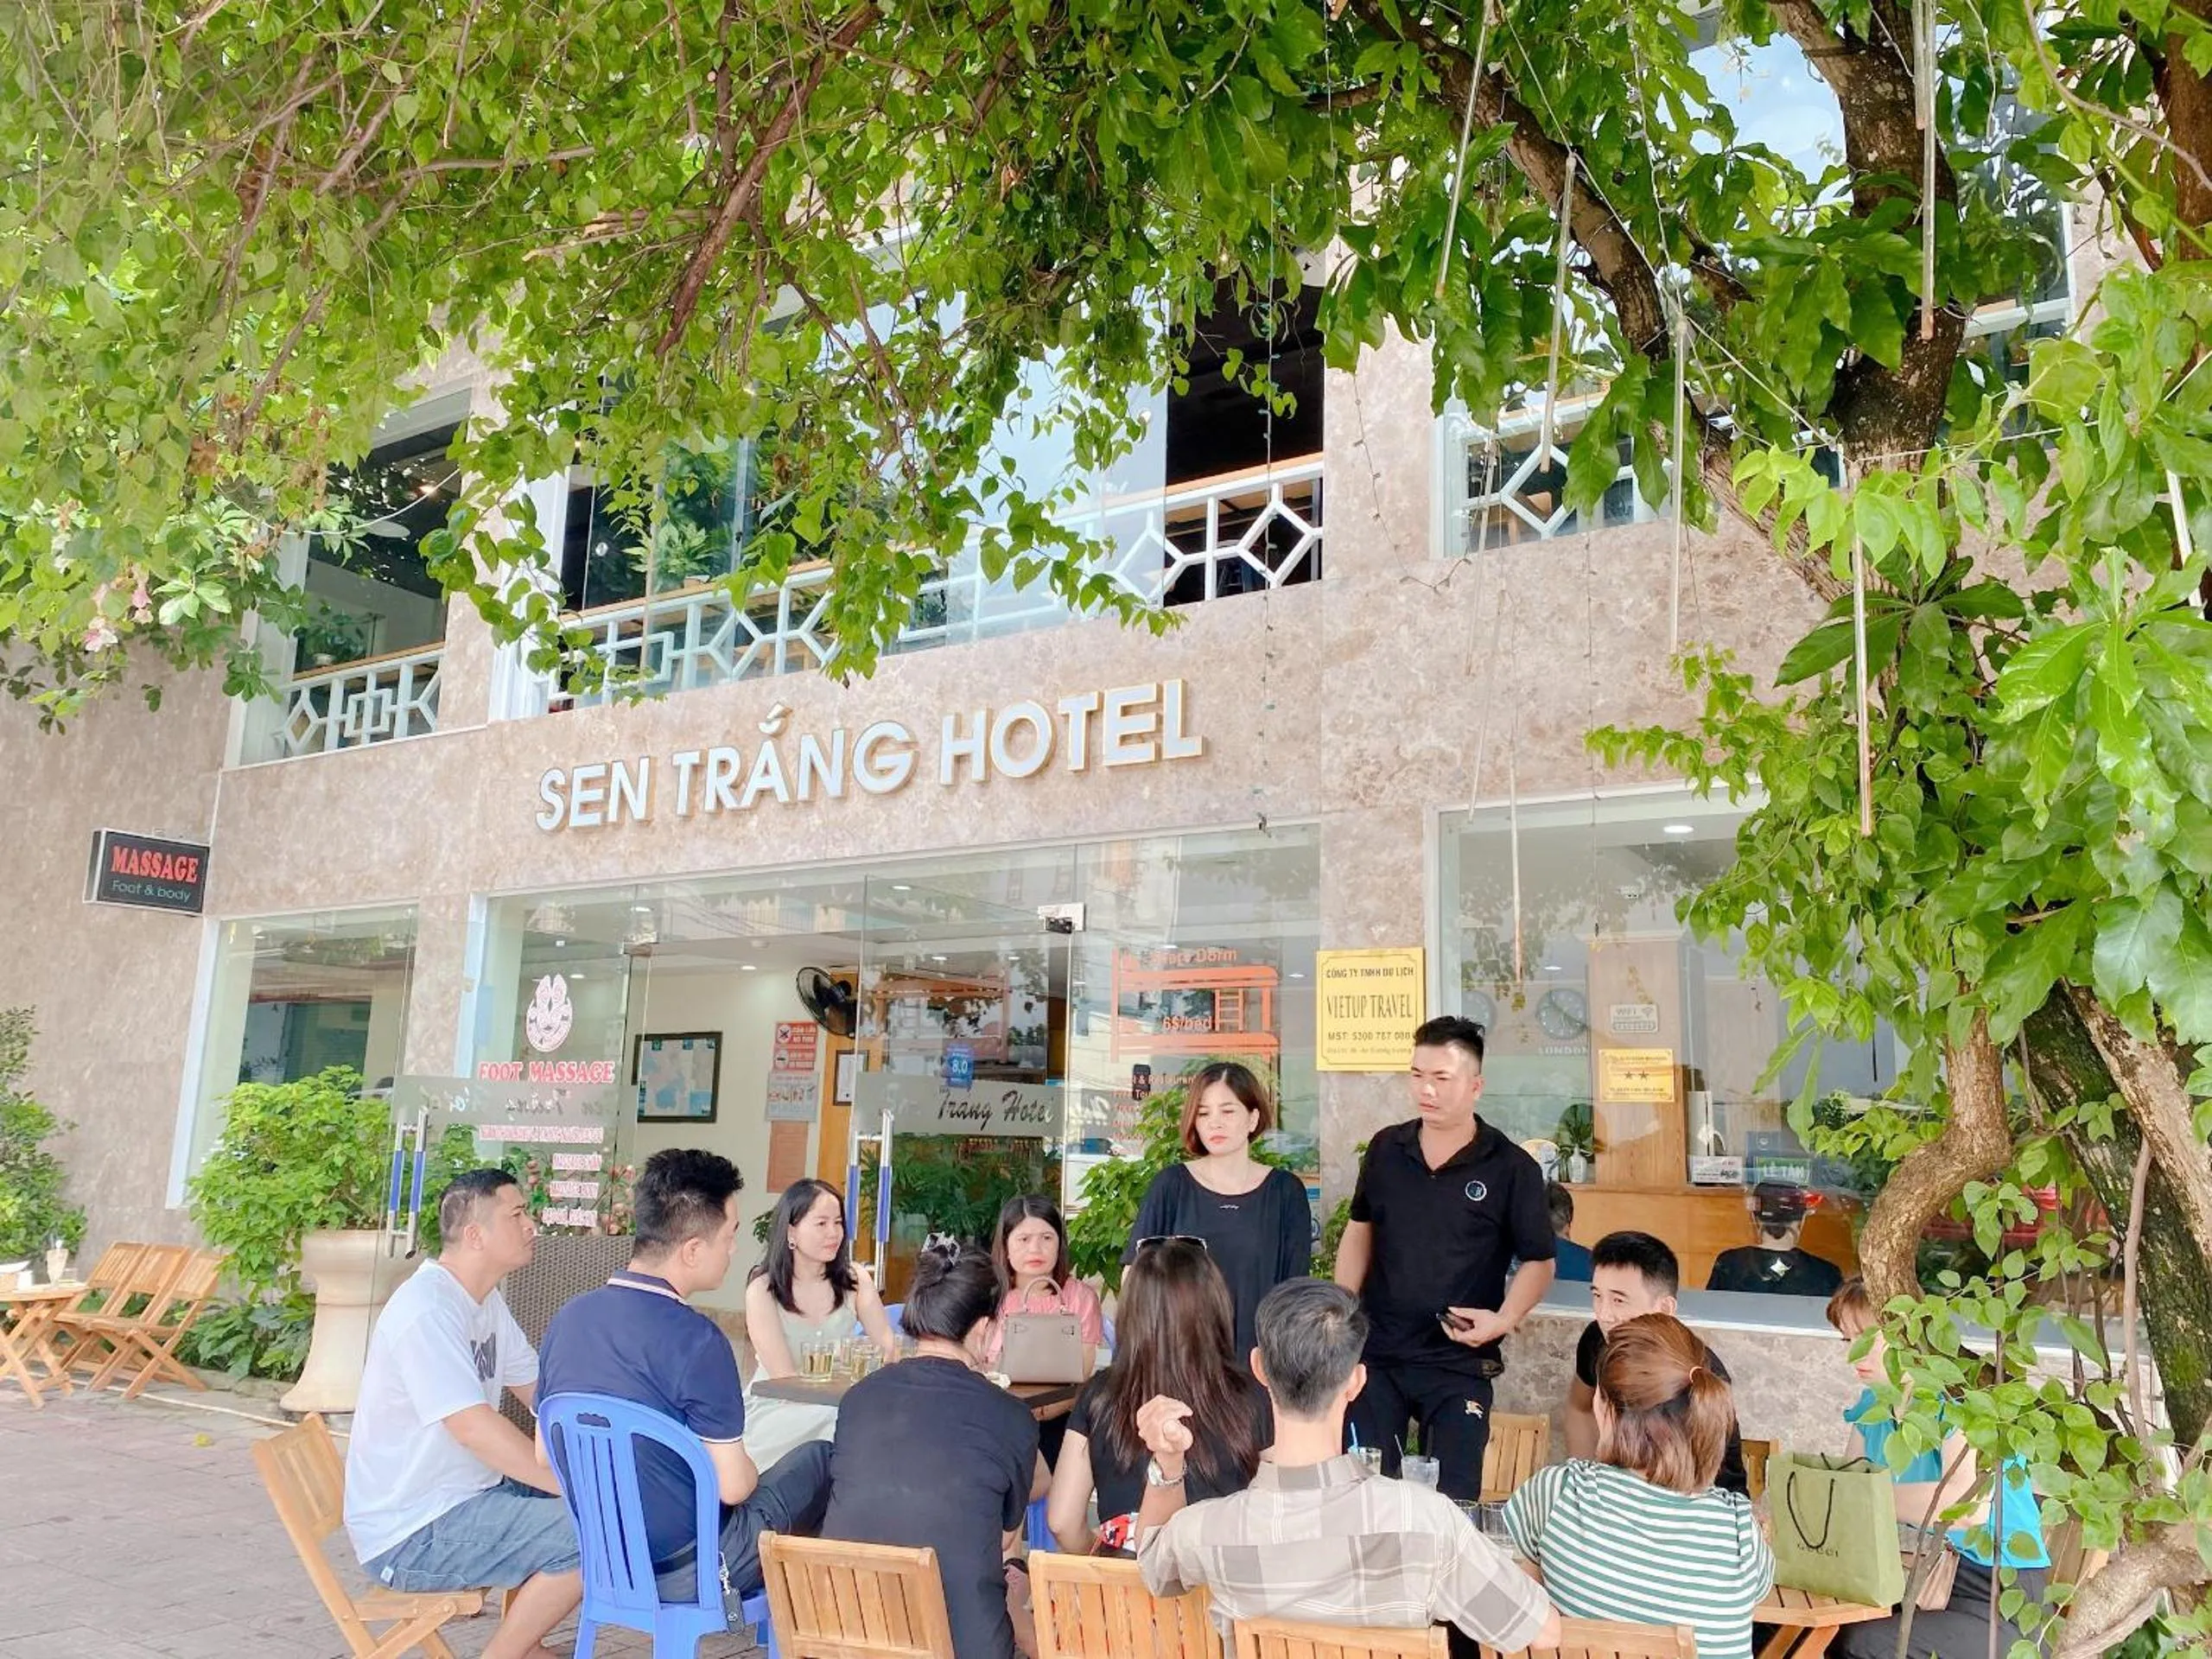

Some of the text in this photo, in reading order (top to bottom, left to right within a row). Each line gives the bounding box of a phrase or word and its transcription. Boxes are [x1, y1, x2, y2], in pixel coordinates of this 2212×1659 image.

[535, 678, 1205, 832] SEN TRẮNG HOTEL
[111, 846, 199, 883] MASSAGE
[112, 880, 191, 902] Foot & body
[1370, 995, 1413, 1019] TRAVEL
[479, 1061, 616, 1084] FOOT MASSAGE
